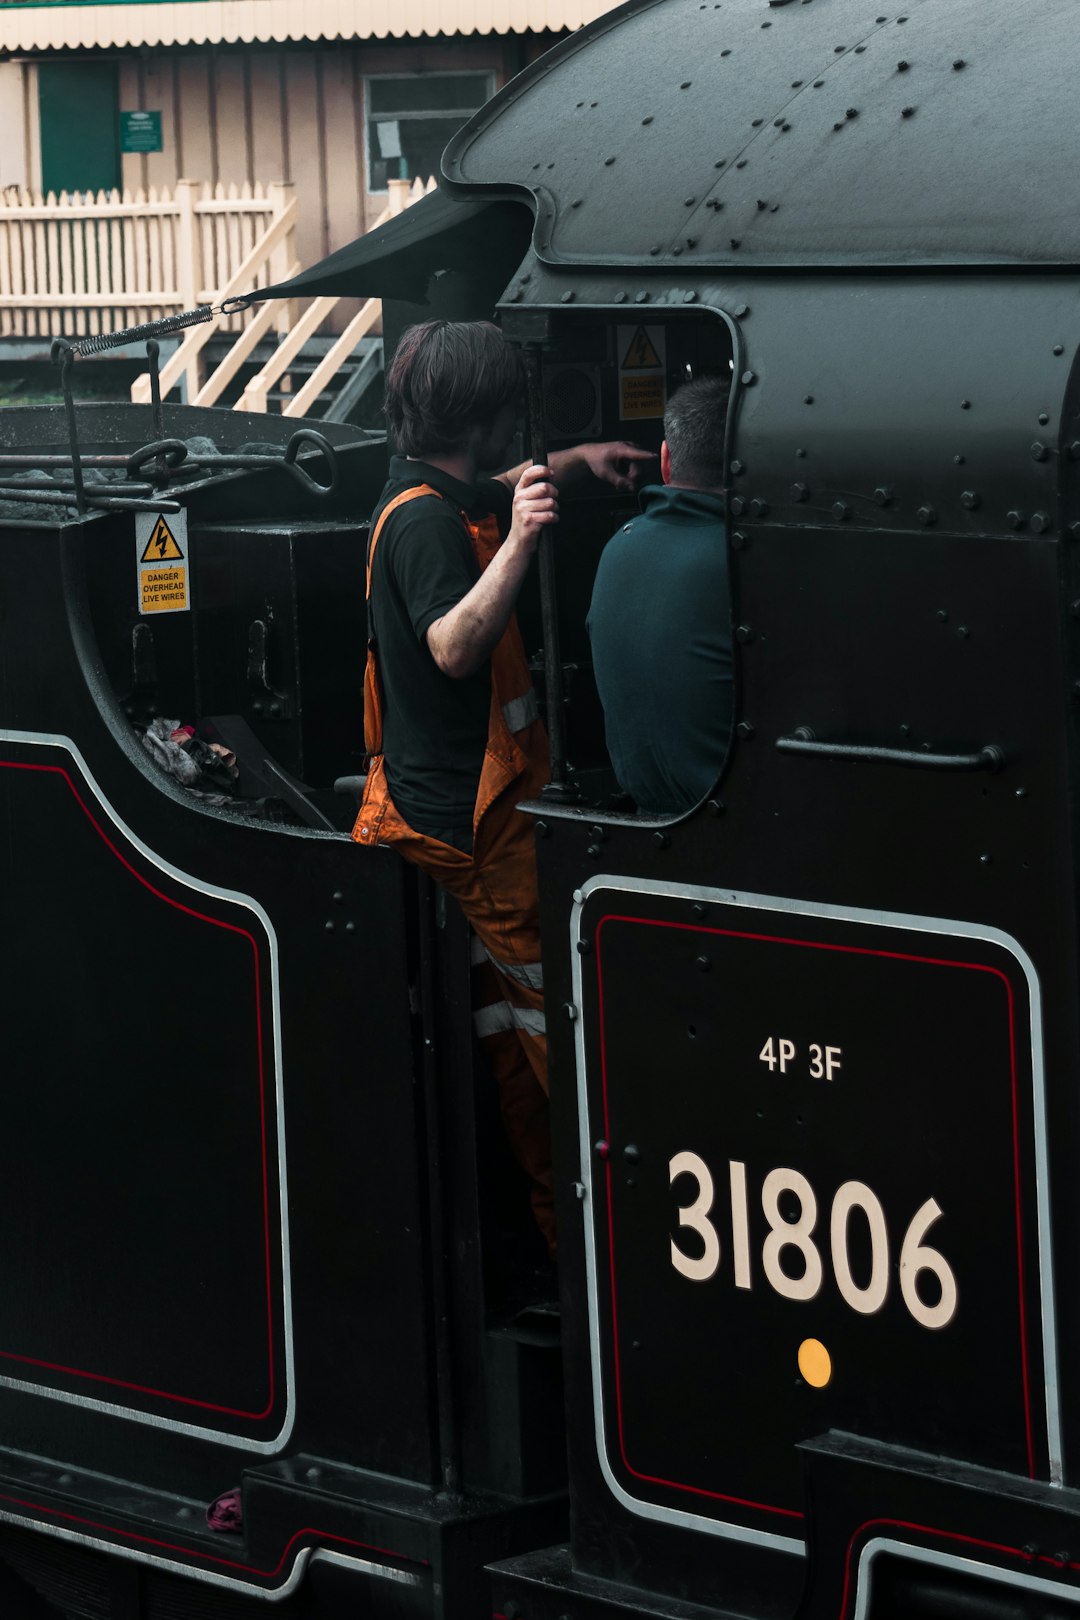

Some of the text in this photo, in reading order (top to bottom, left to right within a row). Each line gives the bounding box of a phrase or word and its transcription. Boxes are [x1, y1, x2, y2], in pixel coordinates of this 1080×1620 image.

[147, 572, 179, 582] DANGER
[143, 582, 184, 592] OVERHEAD
[143, 592, 185, 603] LIVE WIRES
[759, 1036, 842, 1081] 4P 3F
[669, 1151, 958, 1330] 31806
